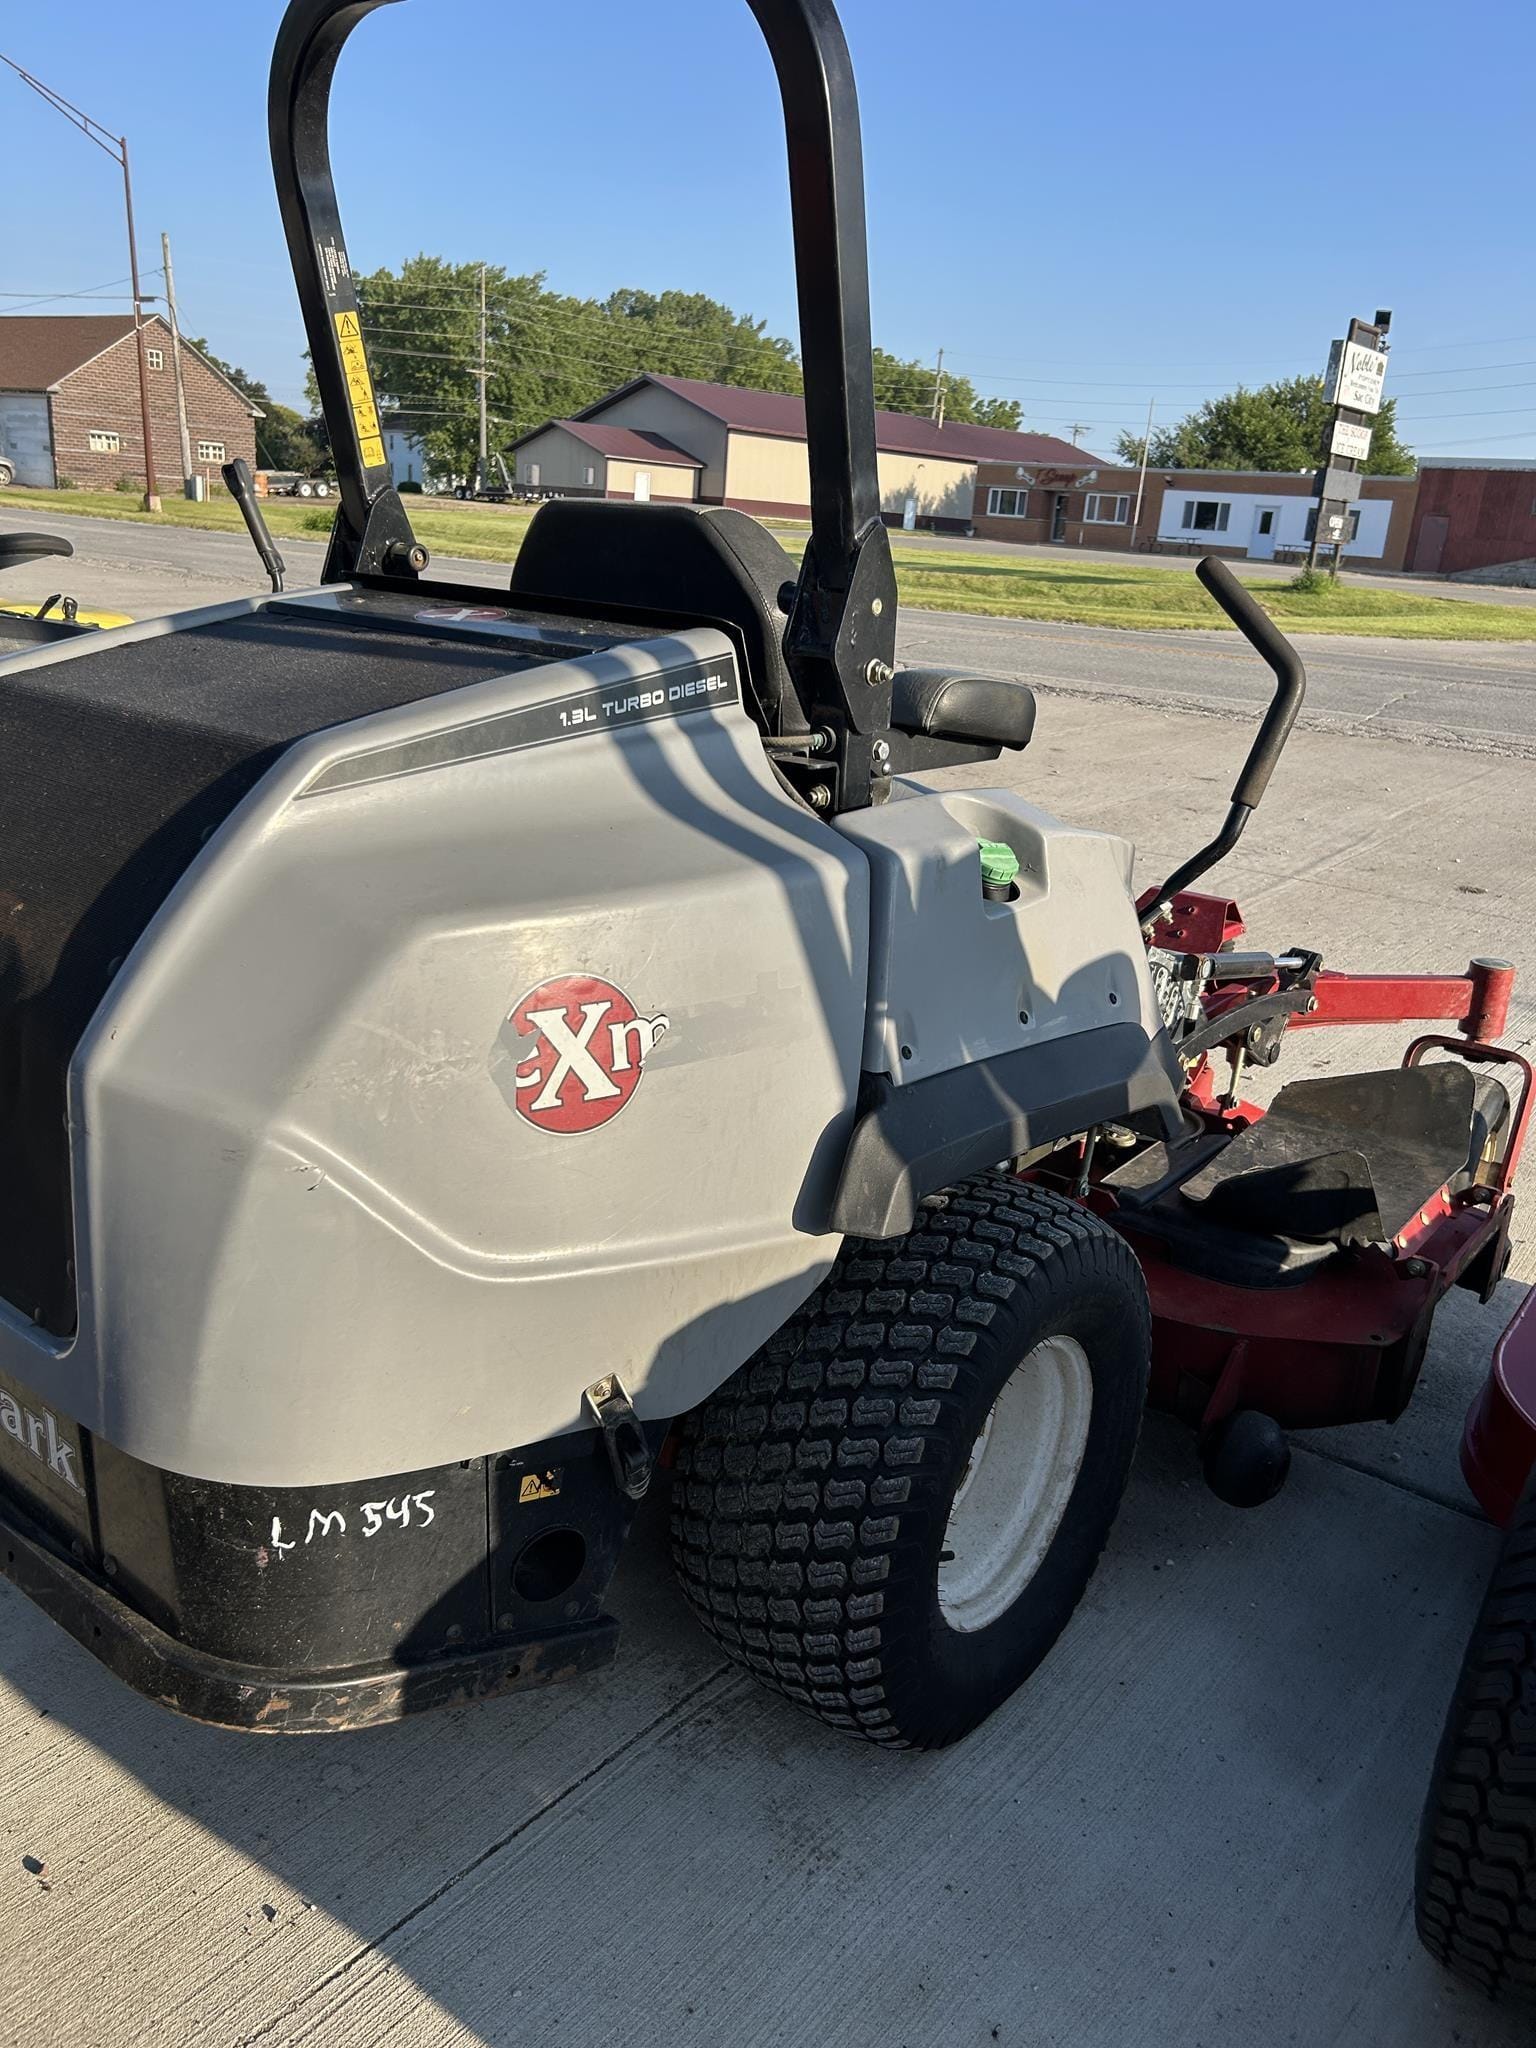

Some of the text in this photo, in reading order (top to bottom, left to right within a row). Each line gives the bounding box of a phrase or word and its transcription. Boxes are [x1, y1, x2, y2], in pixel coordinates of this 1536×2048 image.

[559, 674, 729, 728] 1.3L TURBO DIESEL
